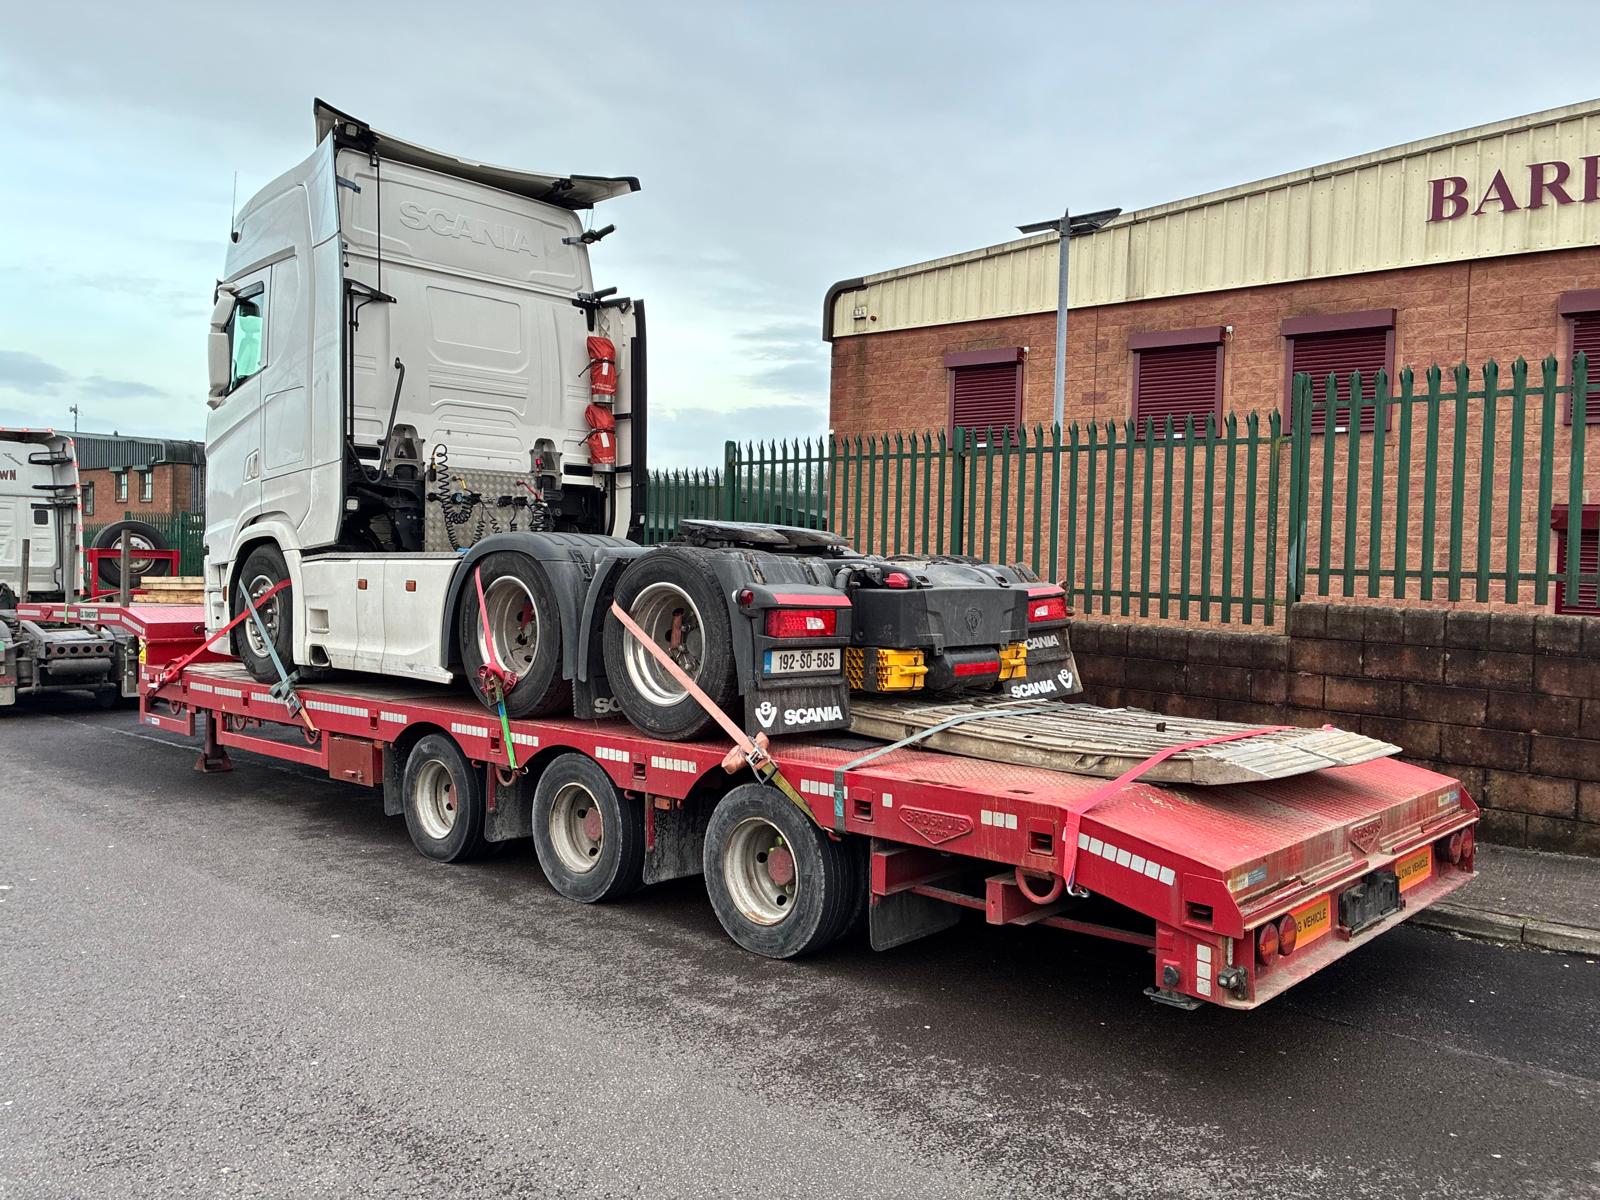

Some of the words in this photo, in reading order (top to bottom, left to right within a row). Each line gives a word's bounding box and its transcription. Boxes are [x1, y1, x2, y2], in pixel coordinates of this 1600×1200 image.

[399, 201, 538, 258] SCANIA
[1025, 634, 1060, 650] CANIA
[779, 652, 835, 670] 192-SO-585
[1011, 679, 1058, 698] SCANIA
[784, 706, 843, 725] SCANIA
[1303, 908, 1327, 928] VEHICLE
